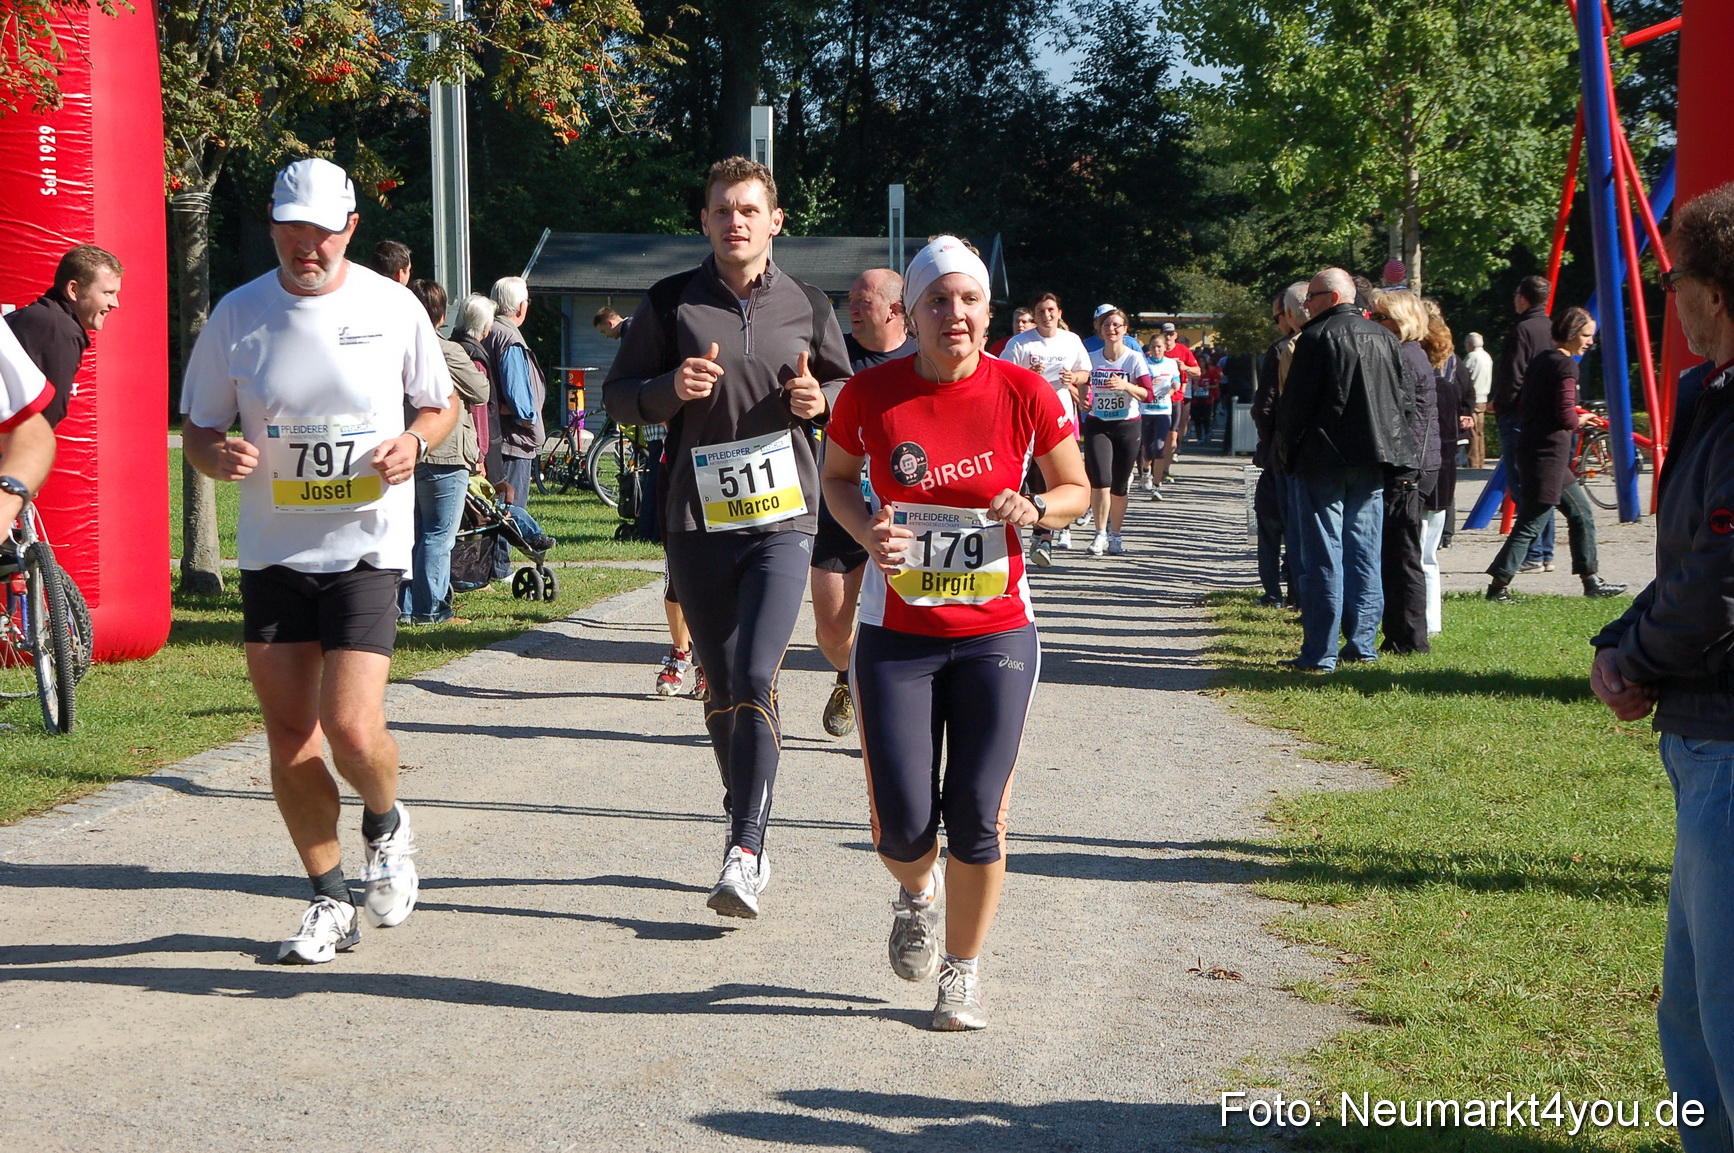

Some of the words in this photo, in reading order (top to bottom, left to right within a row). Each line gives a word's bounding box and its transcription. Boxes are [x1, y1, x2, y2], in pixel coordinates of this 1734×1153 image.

[38, 125, 57, 162] 1929
[40, 168, 57, 196] Seit
[1091, 371, 1109, 379] RADIO
[1097, 397, 1125, 410] 3256
[281, 425, 329, 435] PFLEIDERER
[289, 440, 355, 478] 797
[708, 447, 751, 461] PFLEIDERER
[718, 458, 775, 498] 511
[920, 450, 994, 491] BIRGIT
[301, 480, 353, 501] Josef
[728, 496, 780, 518] Marco
[909, 512, 960, 523] PFLEIDERER
[916, 530, 984, 570] 179
[921, 571, 976, 596] Birgit
